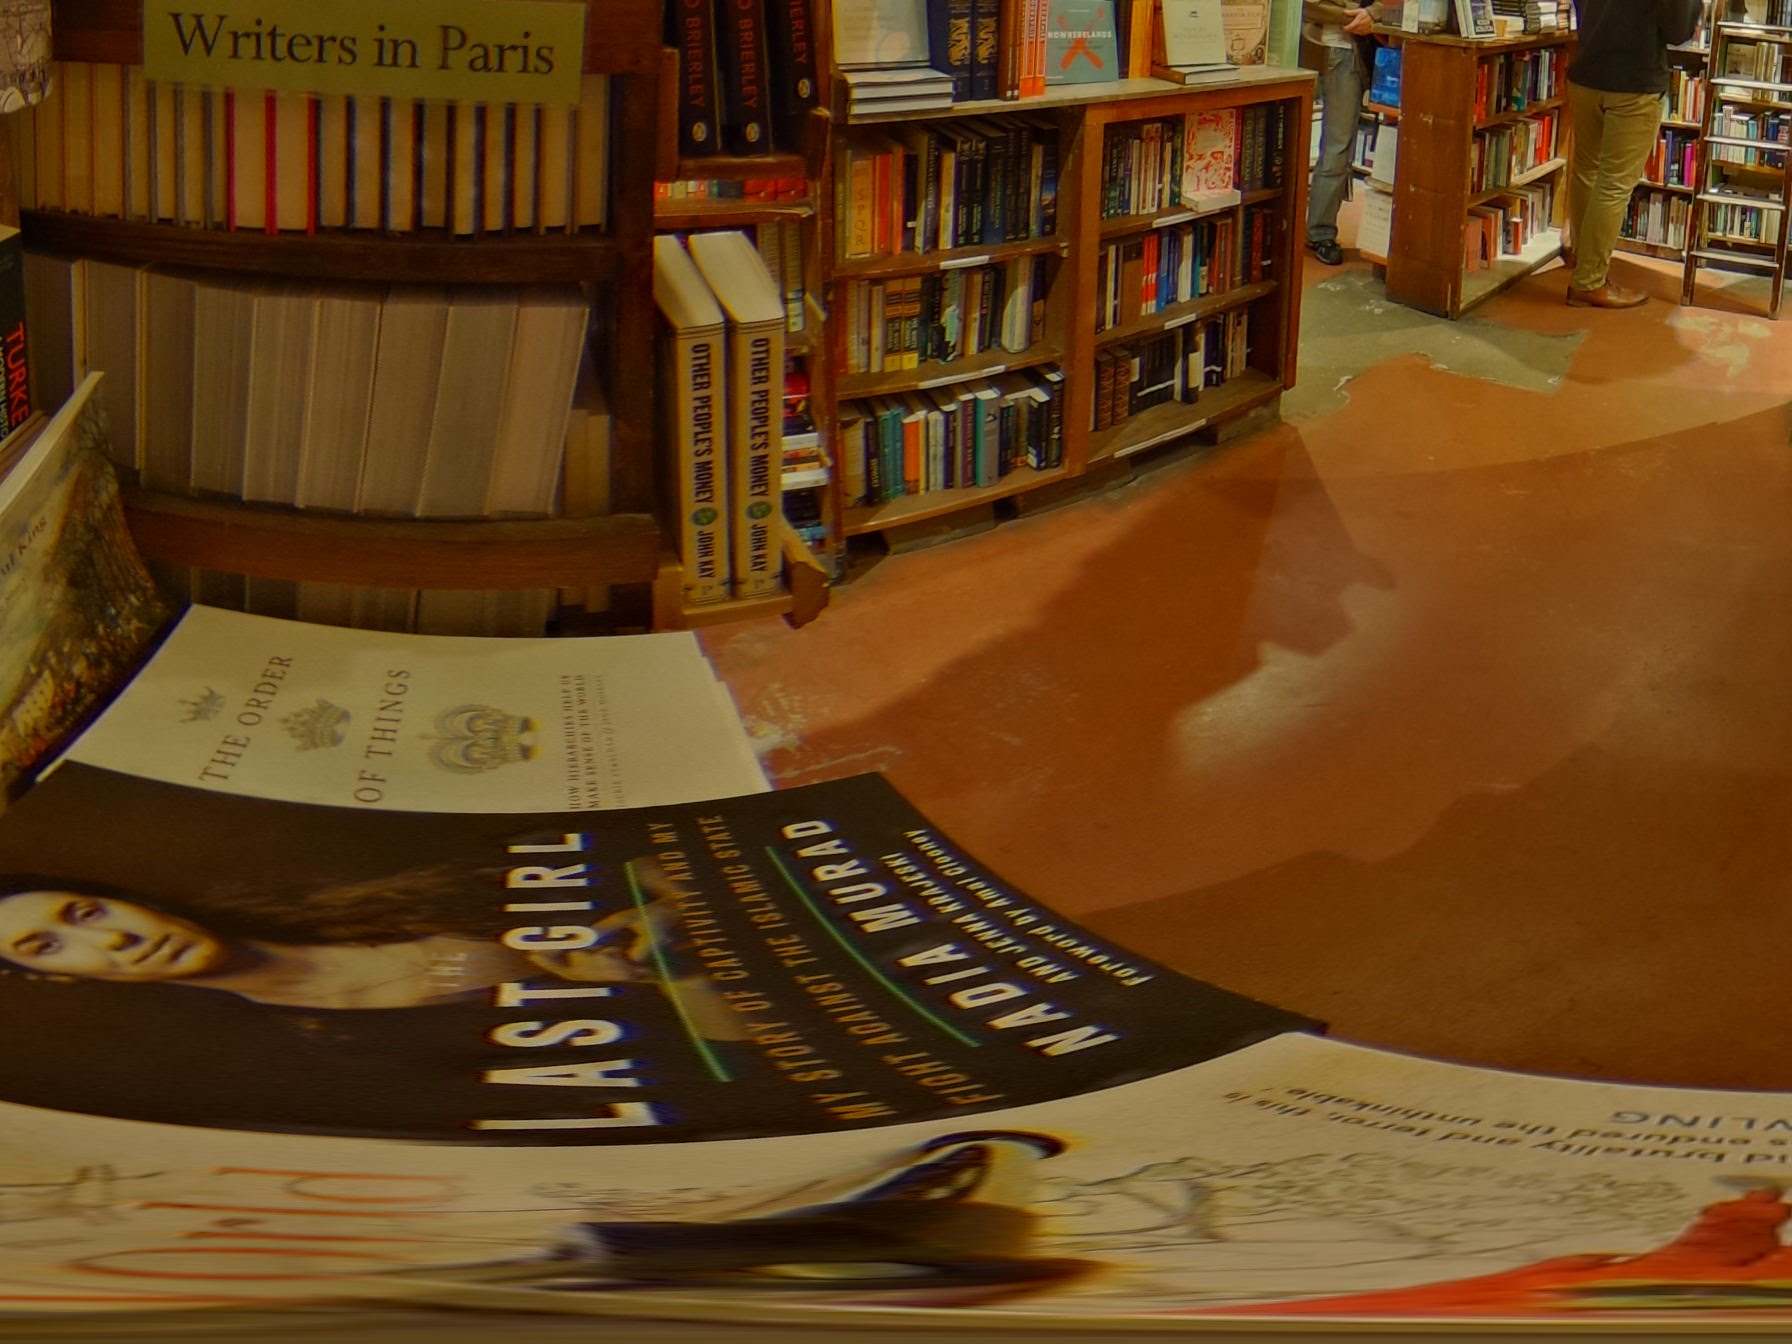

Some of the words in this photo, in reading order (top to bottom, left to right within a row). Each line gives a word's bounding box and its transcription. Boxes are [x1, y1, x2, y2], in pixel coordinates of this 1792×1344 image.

[166, 11, 358, 67] Writers
[373, 23, 418, 69] in
[435, 24, 555, 76] Paris
[684, 17, 706, 110] BRIERLEY
[691, 342, 712, 393] OTHER
[693, 460, 715, 504] MONEY
[697, 558, 716, 579] KAY
[197, 726, 248, 785] THE
[244, 654, 295, 735] ORDER
[366, 667, 411, 748] THINGS
[353, 758, 387, 805] OF
[498, 831, 598, 956] GIRL
[781, 819, 921, 935] MURAD
[894, 942, 1122, 1057] NADIA
[469, 977, 661, 1133] LAST
